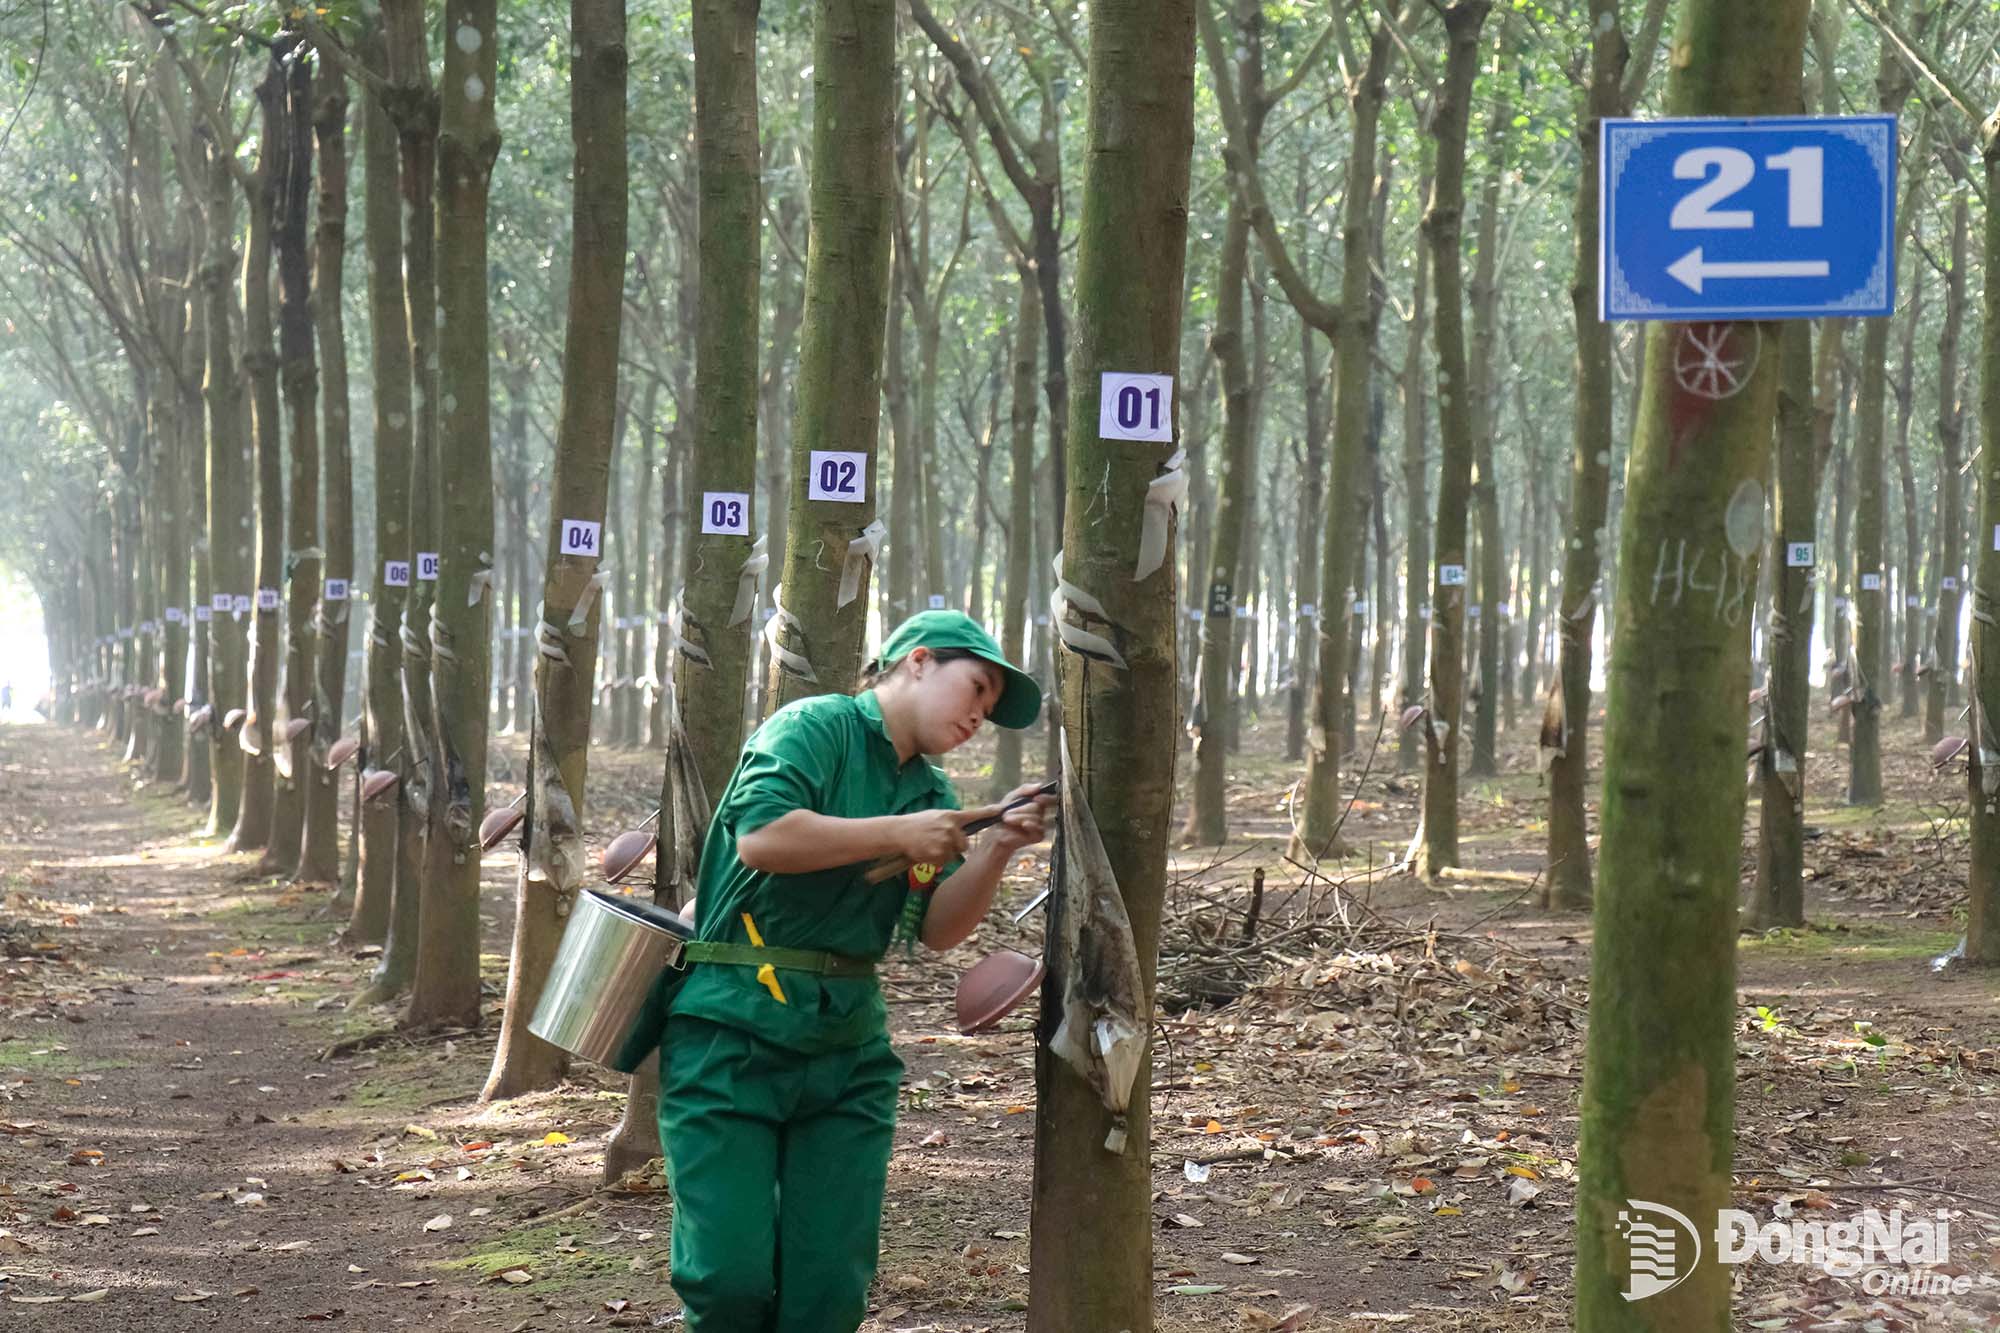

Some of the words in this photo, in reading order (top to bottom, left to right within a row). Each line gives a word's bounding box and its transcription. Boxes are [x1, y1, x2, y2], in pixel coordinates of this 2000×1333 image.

[1670, 146, 1825, 230] 21
[1118, 386, 1161, 429] 01
[820, 460, 857, 493] 02
[711, 500, 742, 528] 03
[568, 527, 593, 550] 04
[1795, 547, 1809, 562] 95
[391, 566, 408, 582] 06
